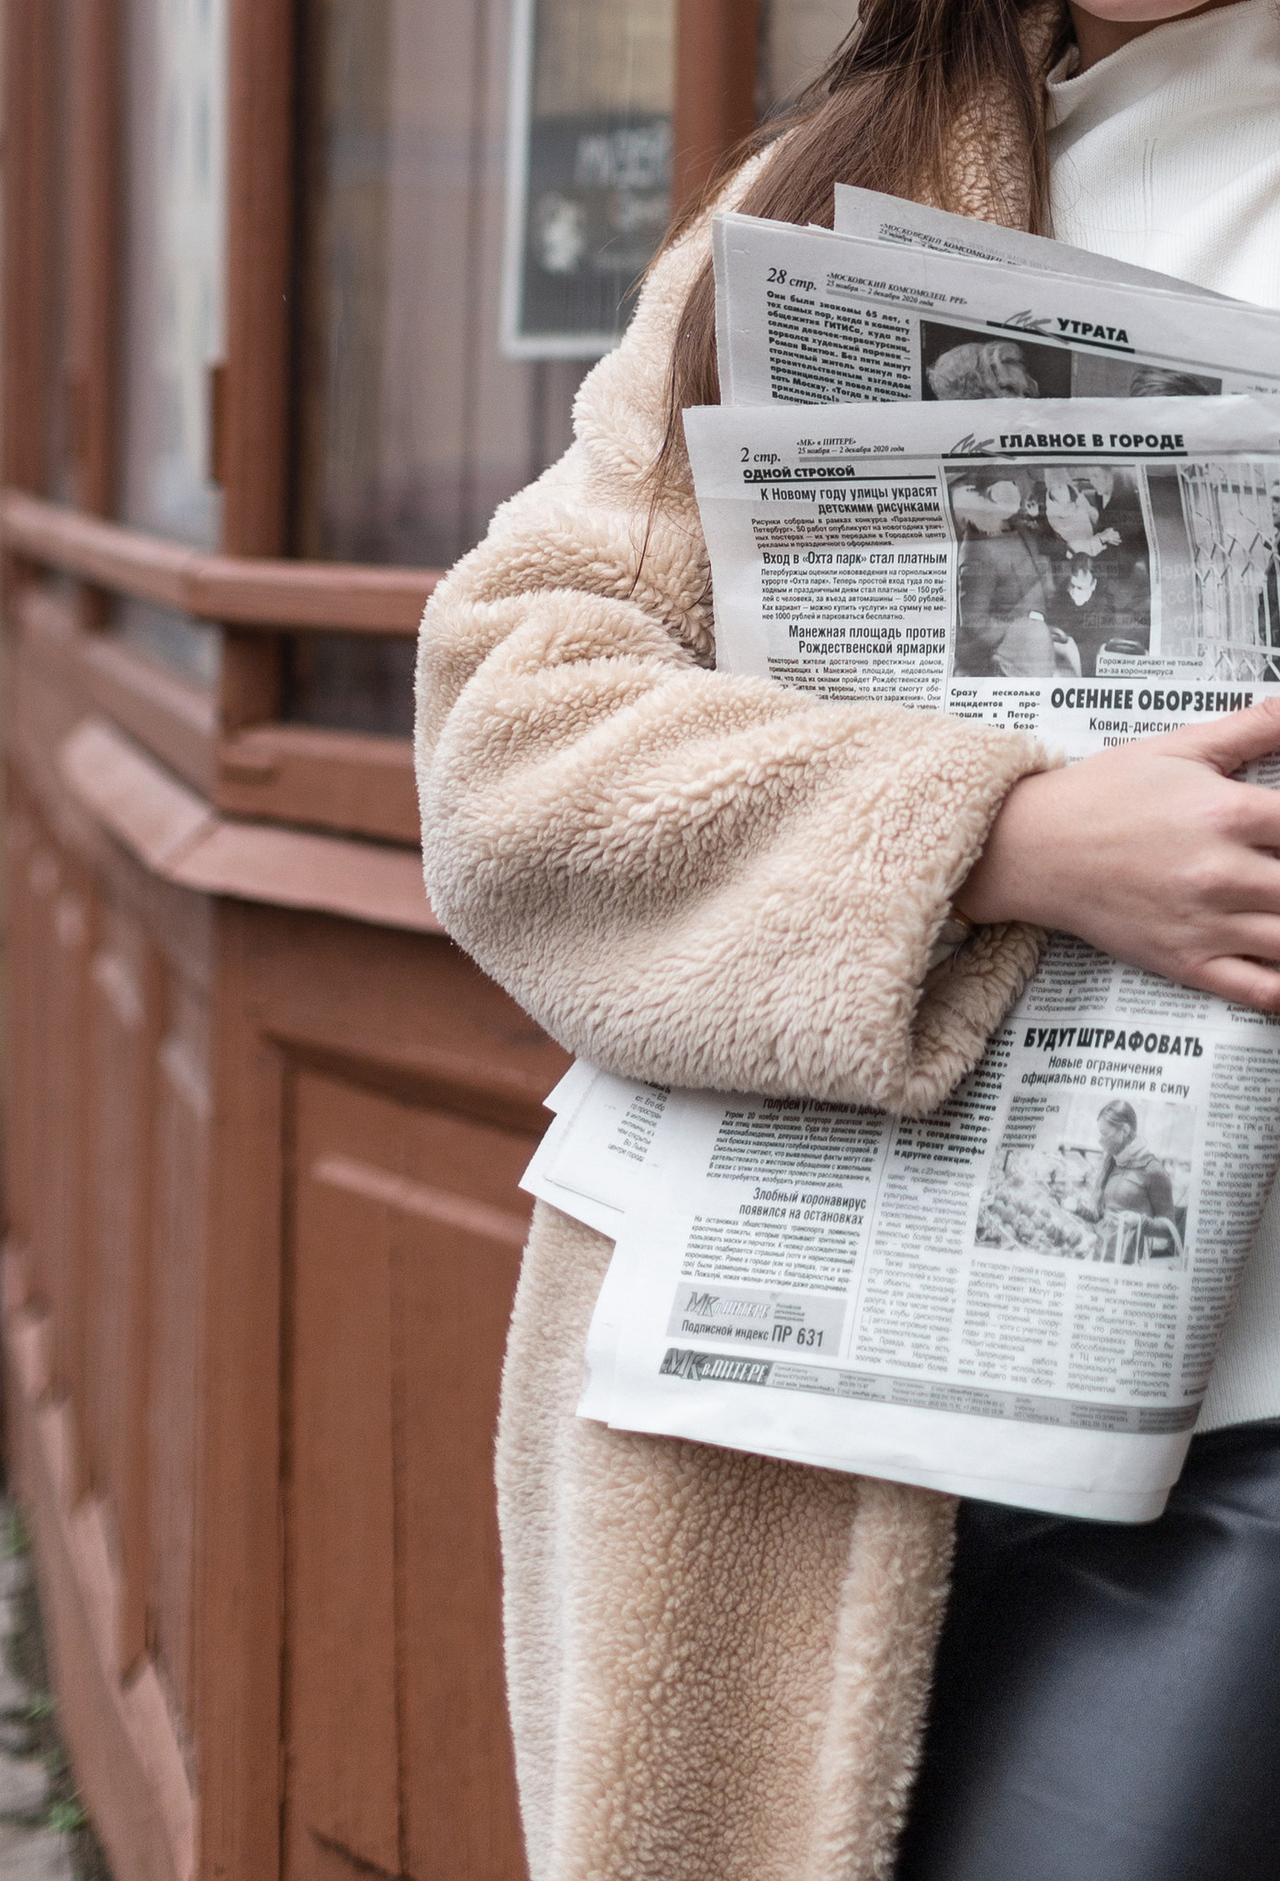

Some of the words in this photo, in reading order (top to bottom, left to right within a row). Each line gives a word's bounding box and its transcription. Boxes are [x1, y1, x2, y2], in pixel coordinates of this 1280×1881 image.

[767, 267, 787, 284] 28
[789, 278, 817, 292] стр.
[826, 279, 834, 287] 25
[835, 283, 859, 292] ноября
[873, 290, 900, 301] декабря
[902, 295, 918, 304] 2020
[767, 290, 786, 300] Они
[790, 295, 815, 306] были
[820, 302, 861, 315] знакомы
[866, 310, 877, 318] 65
[882, 314, 900, 324] лет,
[767, 301, 781, 309] тех
[783, 305, 812, 315] самых
[815, 311, 834, 320] пор,
[837, 315, 862, 325] когда
[871, 322, 910, 335] комнату
[767, 310, 820, 326] общежития
[824, 320, 863, 335] ГИТИСа,
[868, 331, 891, 340] куда
[768, 320, 799, 331] селили
[802, 327, 910, 353] девочек-первокурсниц,
[1057, 317, 1129, 343] УТРАТА
[768, 329, 809, 342] ворвался
[812, 338, 860, 352] худенький
[862, 348, 901, 360] паренек
[769, 337, 798, 349] Роман
[801, 343, 838, 357] Виктюк.
[841, 351, 857, 361] Без
[860, 357, 880, 365] пяти
[883, 361, 911, 372] минут
[807, 447, 830, 455] ноября
[845, 446, 871, 454] декабря
[873, 445, 889, 453] 2020
[1000, 434, 1086, 448] ГЛАВНОЕ
[1092, 434, 1104, 447] В
[1110, 434, 1184, 450] ГОРОДЕ
[741, 447, 749, 462] 2
[753, 454, 781, 465] стр.
[743, 466, 792, 479] ОДНОЙ
[794, 465, 855, 477] СТРОКОЙ
[760, 488, 769, 501] К
[772, 488, 816, 502] Новому
[820, 489, 846, 502] году
[850, 488, 888, 501] улицы
[891, 487, 937, 500] украсят
[818, 504, 874, 515] детскими
[876, 502, 940, 515] рисунками
[751, 518, 781, 528] Рисунки
[784, 517, 815, 527] собраны
[826, 518, 851, 526] рамках
[891, 515, 943, 523] «Праздничный
[762, 552, 790, 566] Вход
[793, 554, 799, 564] в
[803, 551, 833, 564] «Охта
[836, 554, 867, 567] парк»
[870, 554, 894, 564] стал
[898, 554, 947, 564] платным
[761, 568, 808, 577] Петербуржцы
[898, 569, 947, 577] горнолыжном
[833, 577, 857, 585] Теперь
[789, 625, 846, 638] Манежная
[849, 628, 902, 640] площадь
[906, 628, 946, 641] против
[799, 640, 892, 655] Рождественской
[897, 644, 945, 656] ярмарки
[1099, 657, 1135, 666] Горожане
[1120, 668, 1173, 676] коронавируса
[951, 688, 977, 698] Сразу
[1051, 688, 1133, 709] ОСЕННЕЕ
[1138, 689, 1253, 712] ОБОРЗЕНИЕ
[1007, 711, 1039, 720] Петер-
[1013, 722, 1038, 730] безо-
[1023, 1028, 1076, 1052] БУДУТ
[1076, 1028, 1203, 1057] ШТРАФОВАТЬ
[1048, 1056, 1083, 1068] Новые
[1086, 1059, 1163, 1076] ограничения
[1021, 1072, 1087, 1086] официально
[1090, 1076, 1146, 1090] вступили
[1149, 1082, 1156, 1091] в
[1160, 1083, 1190, 1098] силу
[899, 1127, 913, 1135] тов
[926, 1130, 988, 1144] сегодняшнего
[960, 1123, 990, 1133] запре-
[896, 1138, 913, 1146] дня
[916, 1141, 944, 1150] грозят
[948, 1145, 985, 1155] штрафы
[900, 1151, 932, 1160] другие
[933, 1154, 972, 1164] санкции.
[753, 1187, 798, 1202] Злобный
[801, 1194, 866, 1211] коронавирус
[739, 1204, 786, 1218] появился
[789, 1209, 801, 1219] на
[803, 1210, 864, 1224] остановках
[681, 1320, 733, 1336] Подписной
[735, 1329, 769, 1340] индекс
[771, 1324, 792, 1342] ПР
[797, 1327, 823, 1347] 631
[664, 1348, 709, 1382] МК
[702, 1363, 712, 1377] в
[710, 1359, 769, 1384] ПИТЕРЕ
